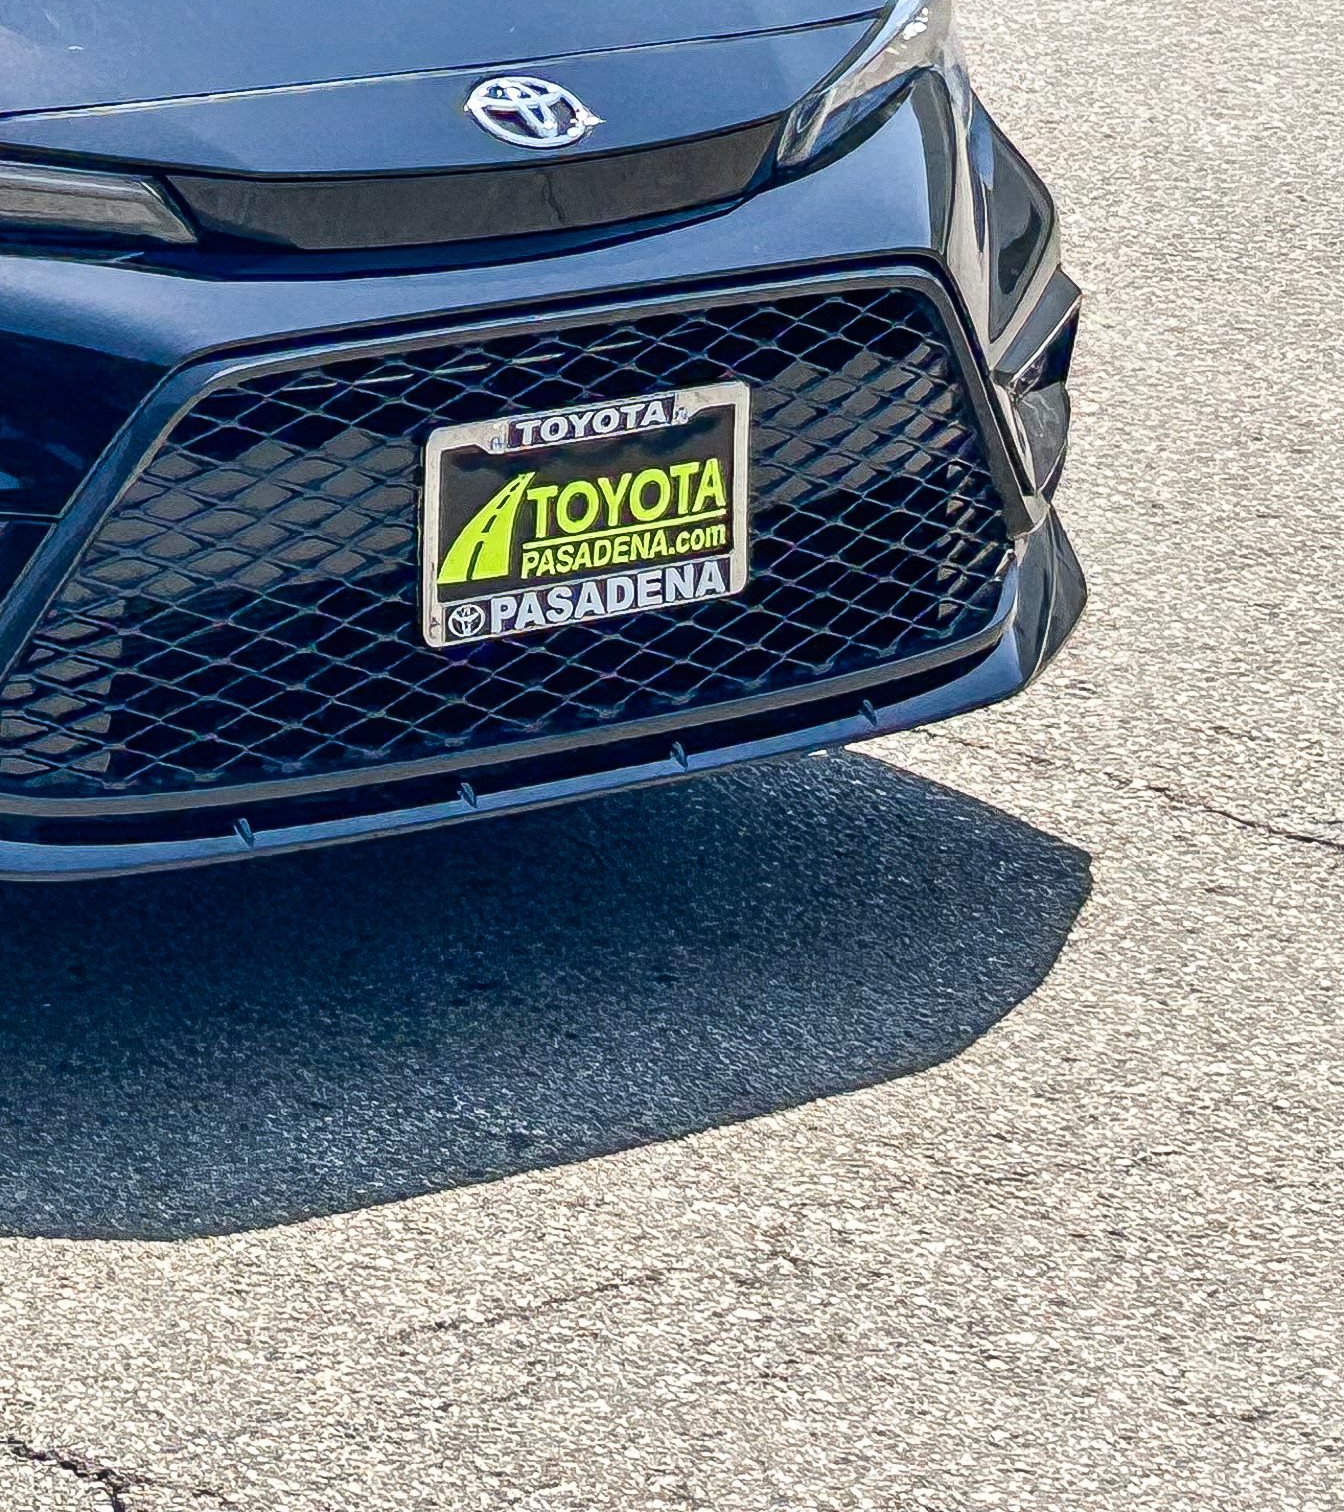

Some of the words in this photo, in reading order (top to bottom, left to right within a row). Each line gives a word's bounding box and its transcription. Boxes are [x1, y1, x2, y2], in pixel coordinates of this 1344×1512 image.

[515, 401, 668, 445] TOYOTA
[526, 457, 727, 538] TOYOTA
[520, 523, 727, 579] PASADENA.com
[490, 560, 726, 633] PASADENA
